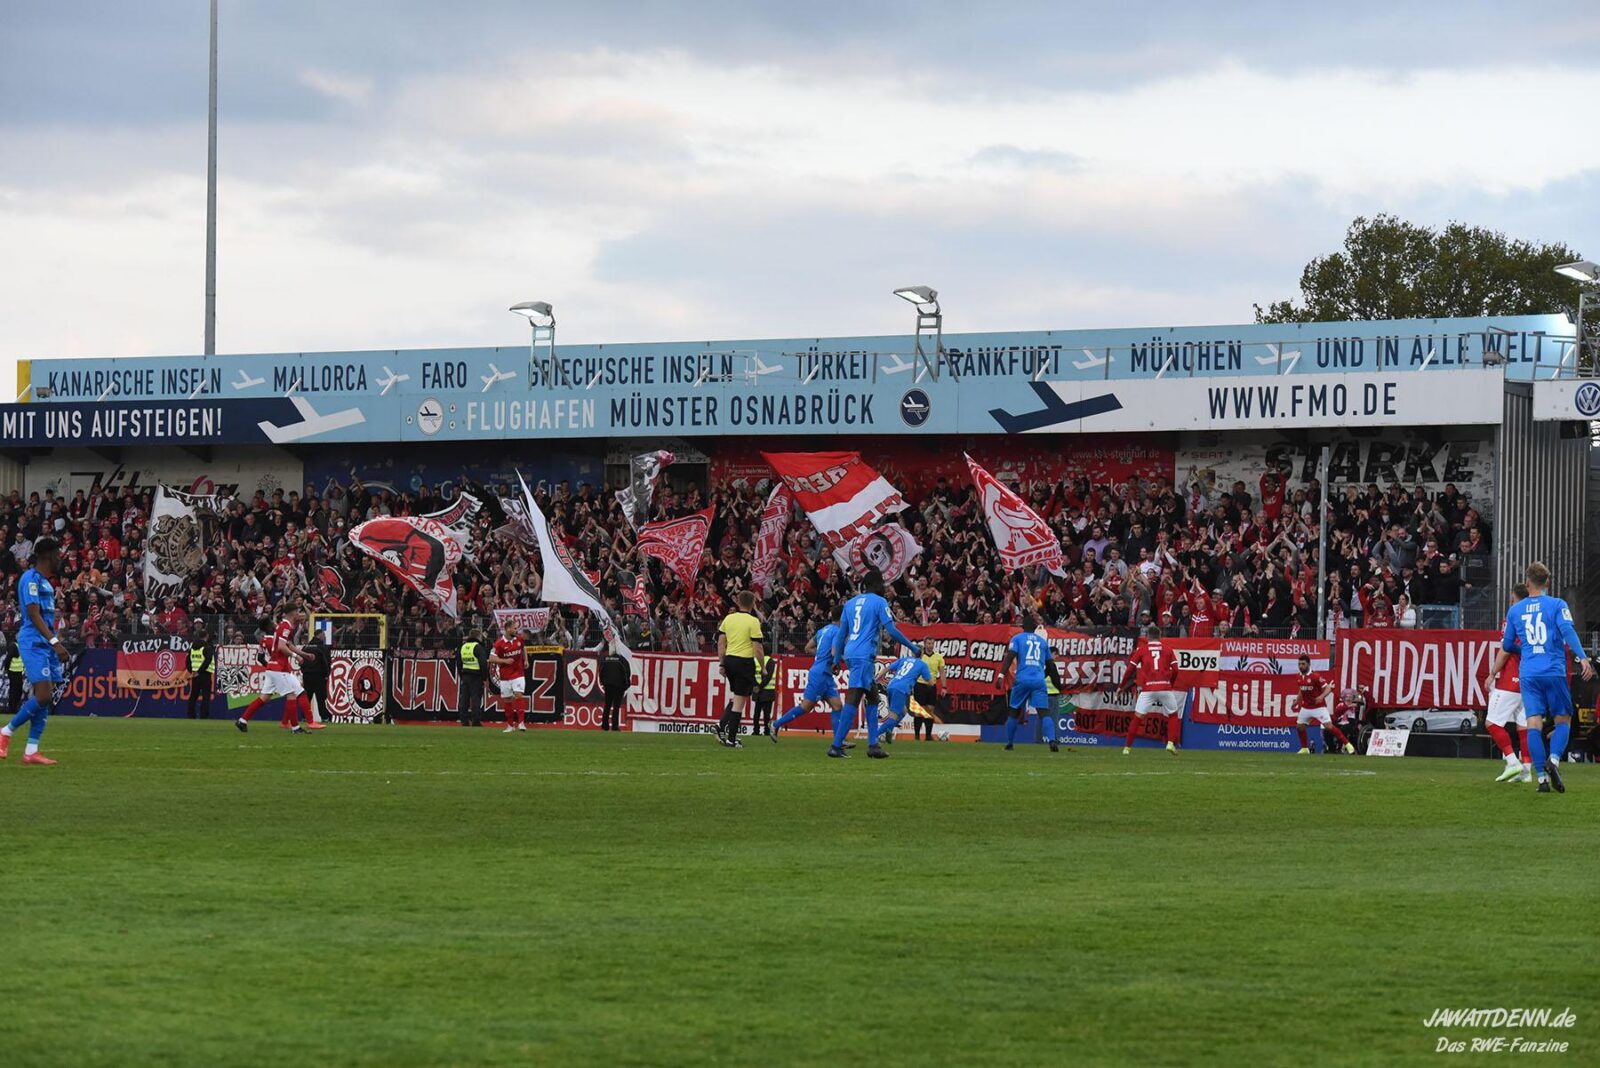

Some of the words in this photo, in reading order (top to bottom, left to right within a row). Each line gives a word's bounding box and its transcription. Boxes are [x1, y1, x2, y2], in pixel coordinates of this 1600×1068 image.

[796, 346, 867, 380] TÜRKEI
[937, 345, 1063, 376] FRANKFURT
[1130, 336, 1242, 372] MÜNCHEN
[1317, 336, 1364, 368] UND
[1376, 335, 1400, 366] IN
[1410, 333, 1470, 365] ALLE
[1482, 331, 1546, 363] WELT
[50, 370, 154, 397] KANARISCHE
[161, 367, 222, 395] INSELN
[274, 364, 367, 392] MALLORCA
[422, 361, 468, 389] FARO
[528, 356, 655, 387] GRIECHISCHE
[662, 355, 733, 384] INSELN
[467, 399, 596, 431] FLUGHAFEN
[610, 392, 719, 428] MÜNSTER
[730, 388, 875, 426] OSNABRÜCK
[1207, 381, 1398, 419] WWW.FMO.DE
[3, 411, 36, 439] MIT
[46, 410, 83, 438] UNS
[91, 408, 223, 438] AUFSTEIGEN!
[1521, 612, 1548, 645] 36
[352, 650, 383, 658] ESSENER
[970, 641, 1006, 661] CREW
[1025, 640, 1041, 660] 23
[1152, 651, 1160, 670] 7
[1179, 652, 1217, 671] Boys
[1226, 642, 1263, 654] WAHRE
[1266, 643, 1320, 655] FUSSBALL
[626, 657, 697, 717] RUDE
[964, 666, 995, 682] ESSEN
[564, 706, 627, 727] BOGL
[1218, 739, 1290, 749] www.adconterra.de
